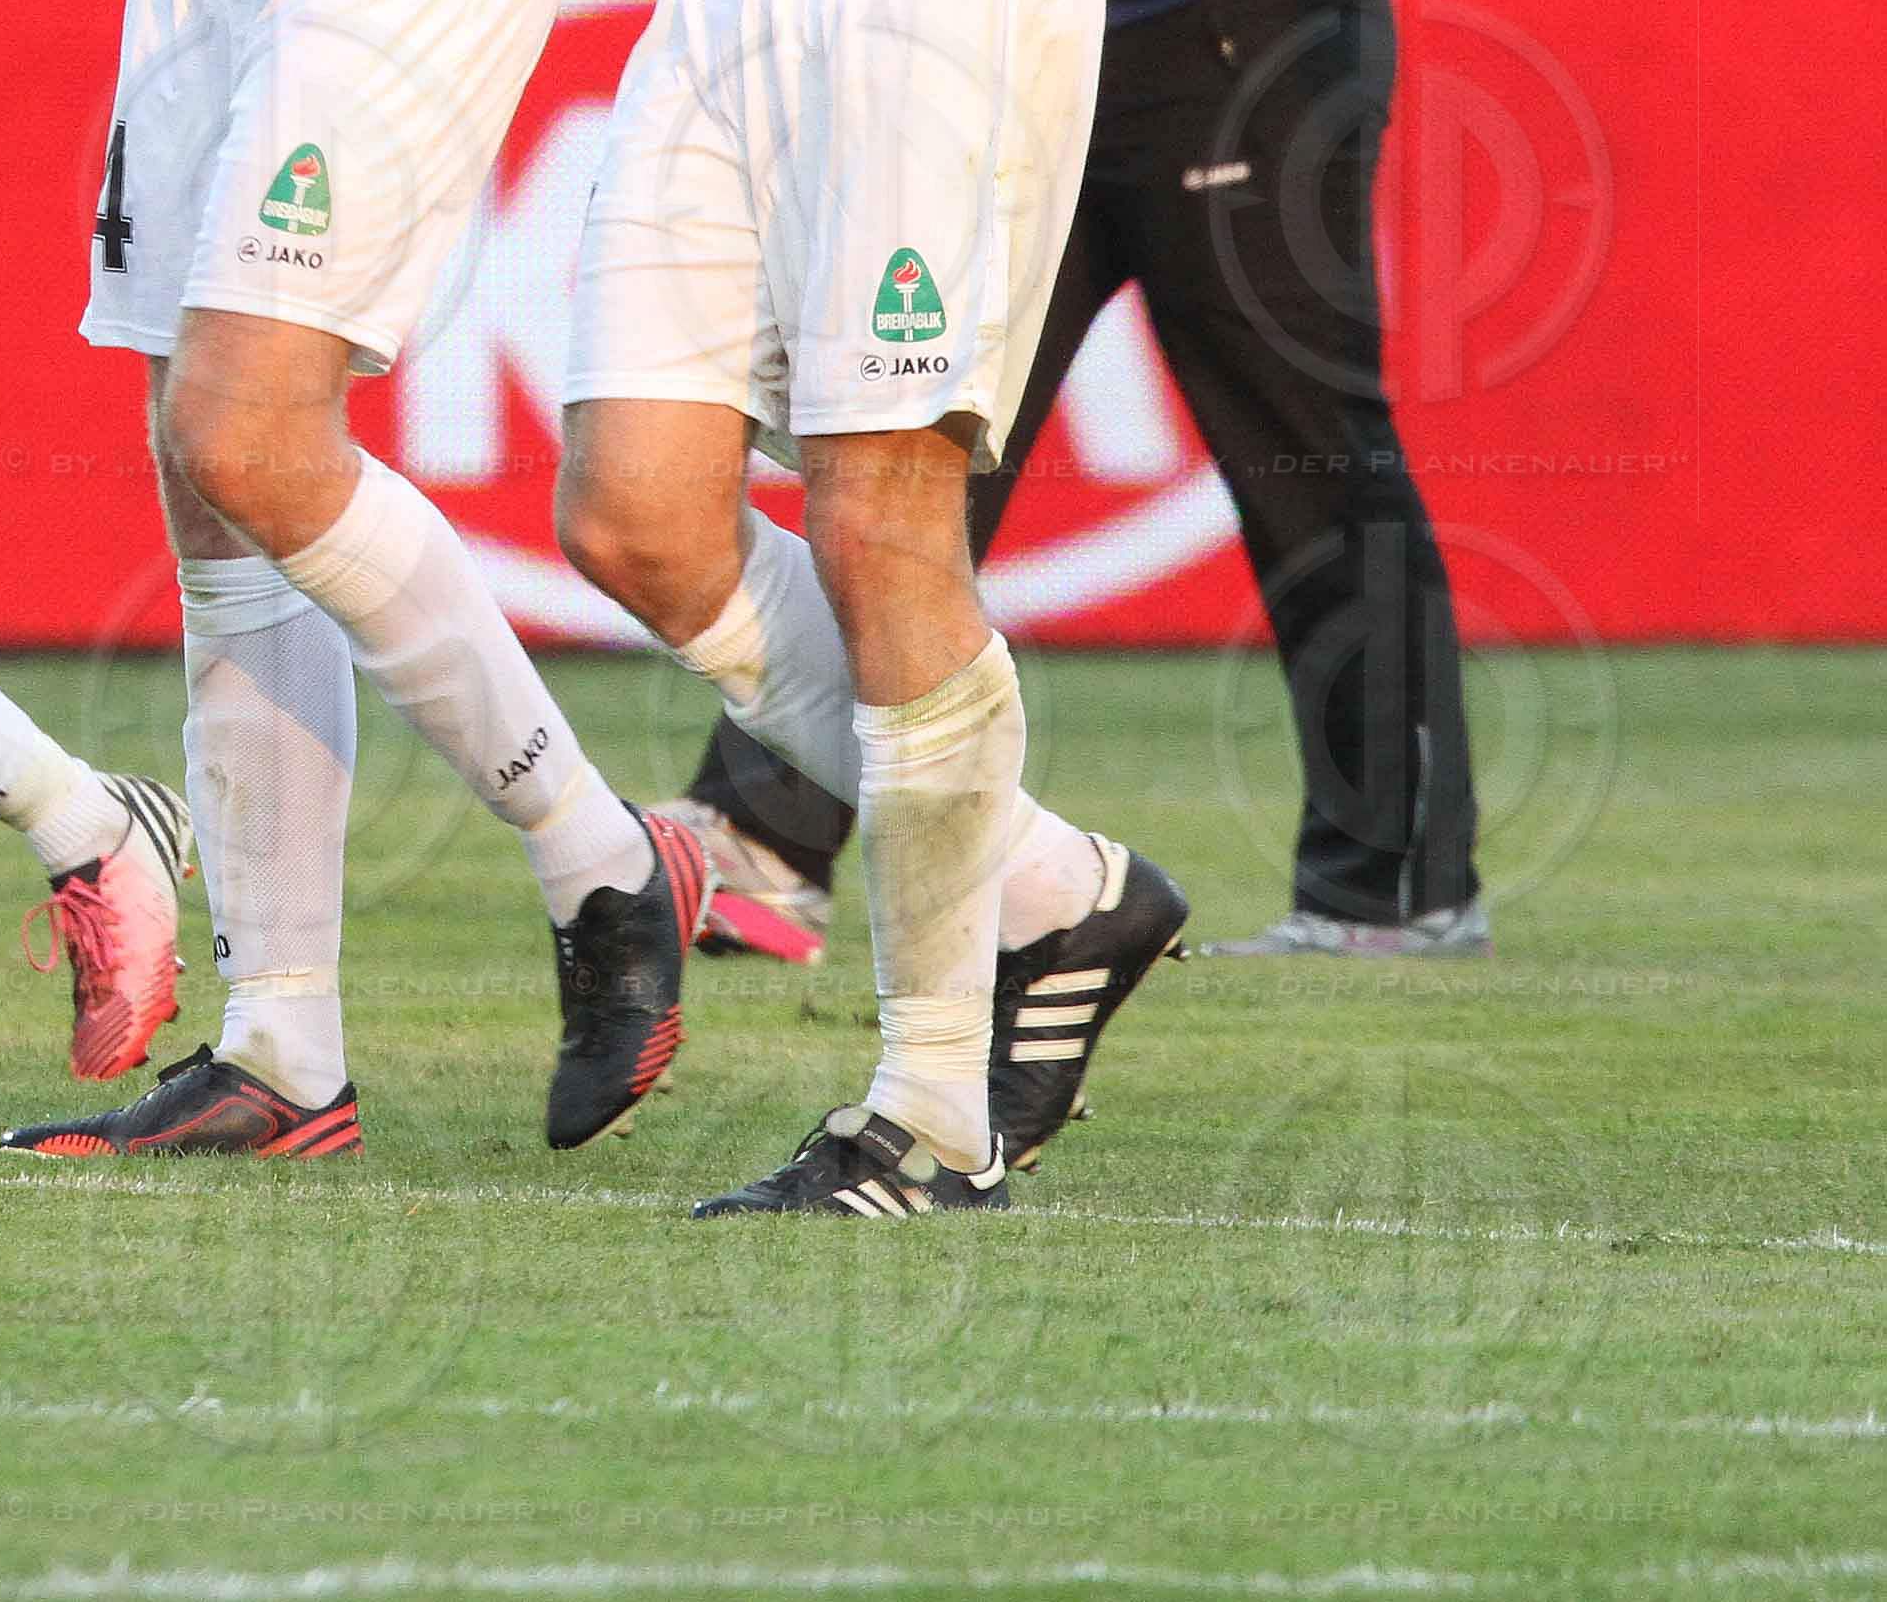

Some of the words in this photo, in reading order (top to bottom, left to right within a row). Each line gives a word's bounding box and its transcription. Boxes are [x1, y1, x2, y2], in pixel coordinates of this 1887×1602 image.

[266, 245, 322, 269] JAKO
[890, 356, 949, 376] JAKO
[496, 727, 547, 790] JAKO
